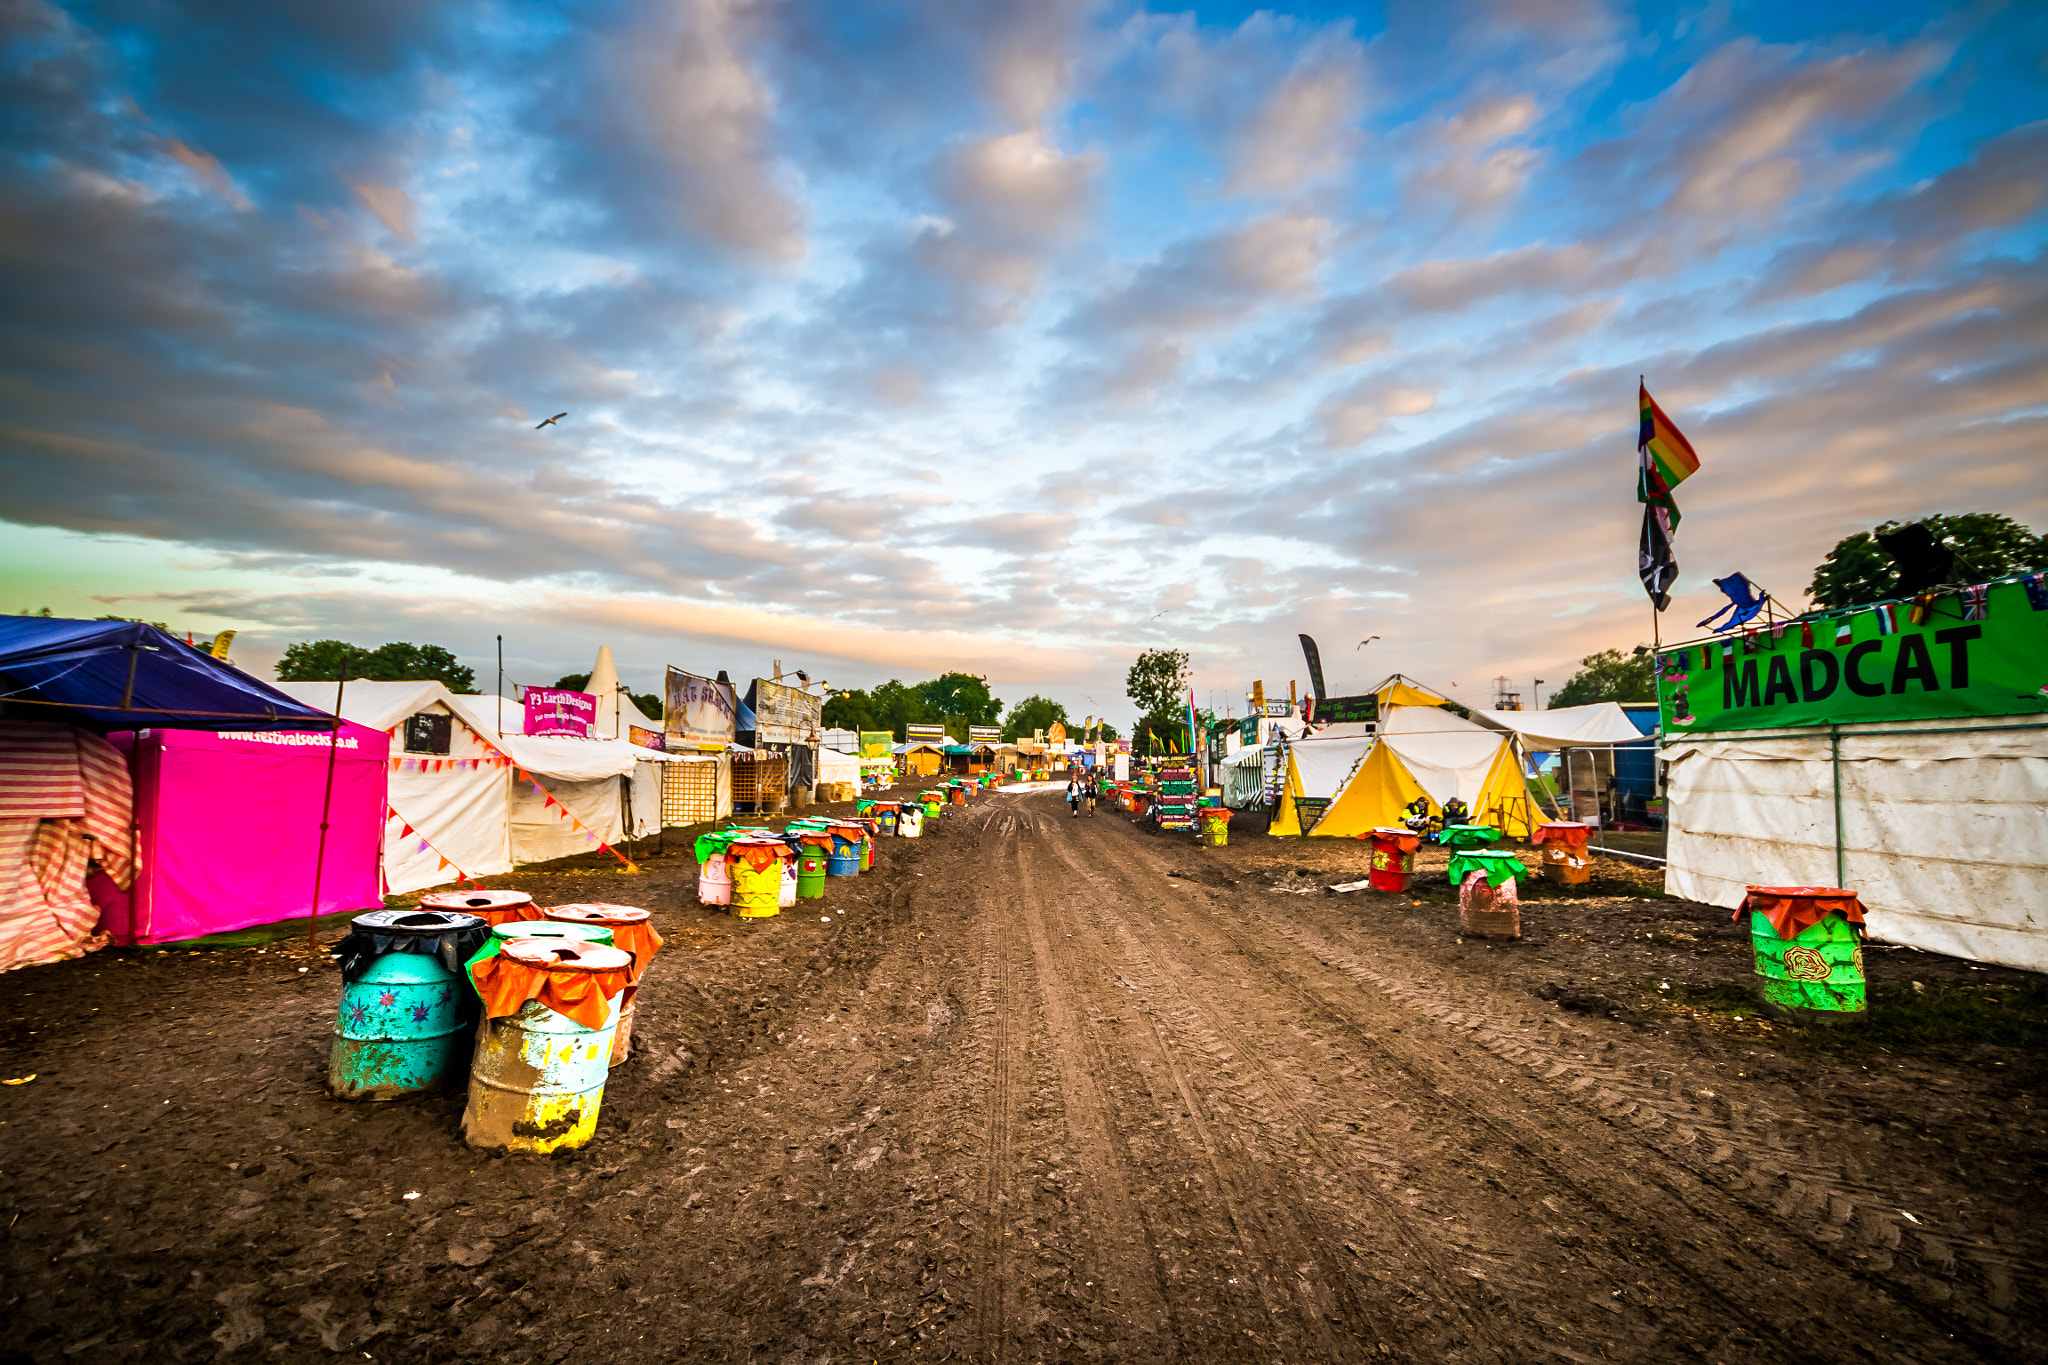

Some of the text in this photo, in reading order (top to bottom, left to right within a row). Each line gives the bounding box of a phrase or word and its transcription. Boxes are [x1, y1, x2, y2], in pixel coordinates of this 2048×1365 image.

[1722, 624, 1982, 710] MADCAT
[529, 692, 592, 710] P3 Earth Designs
[673, 684, 697, 711] HAT
